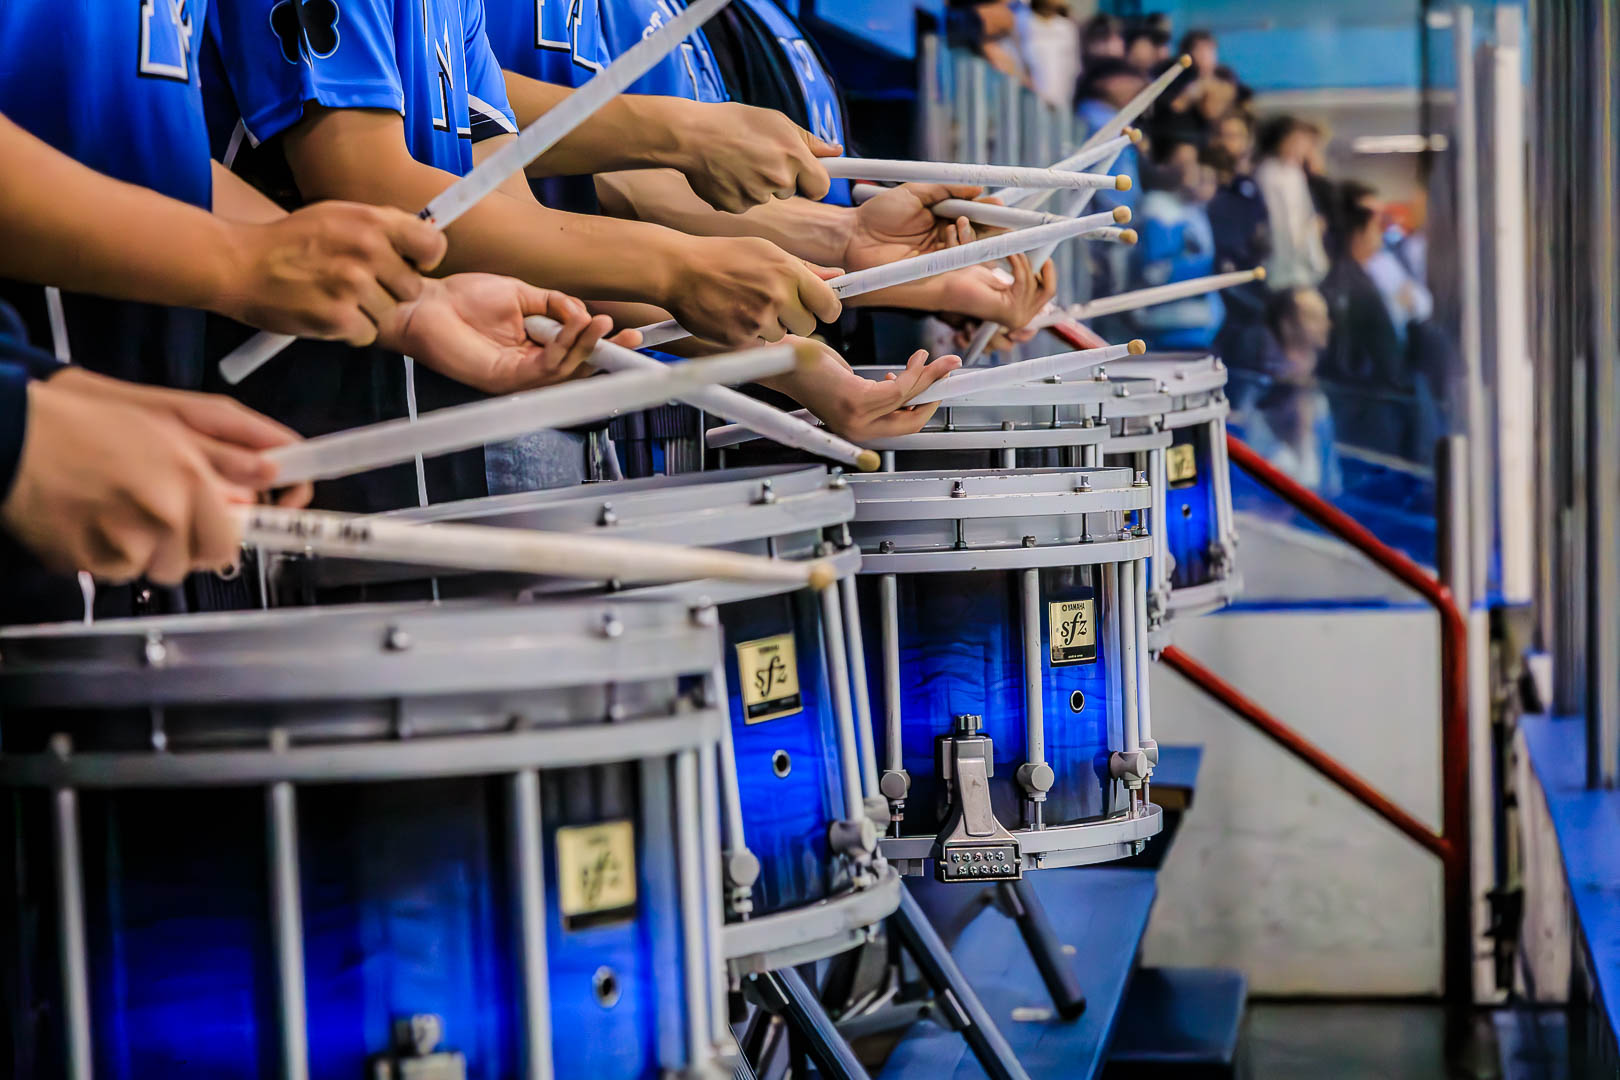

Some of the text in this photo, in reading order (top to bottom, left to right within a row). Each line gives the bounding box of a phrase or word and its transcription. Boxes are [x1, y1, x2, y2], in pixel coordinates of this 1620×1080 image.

[1067, 602, 1085, 611] YAMAHA
[1061, 611, 1087, 645] sfz
[755, 655, 787, 697] sfz
